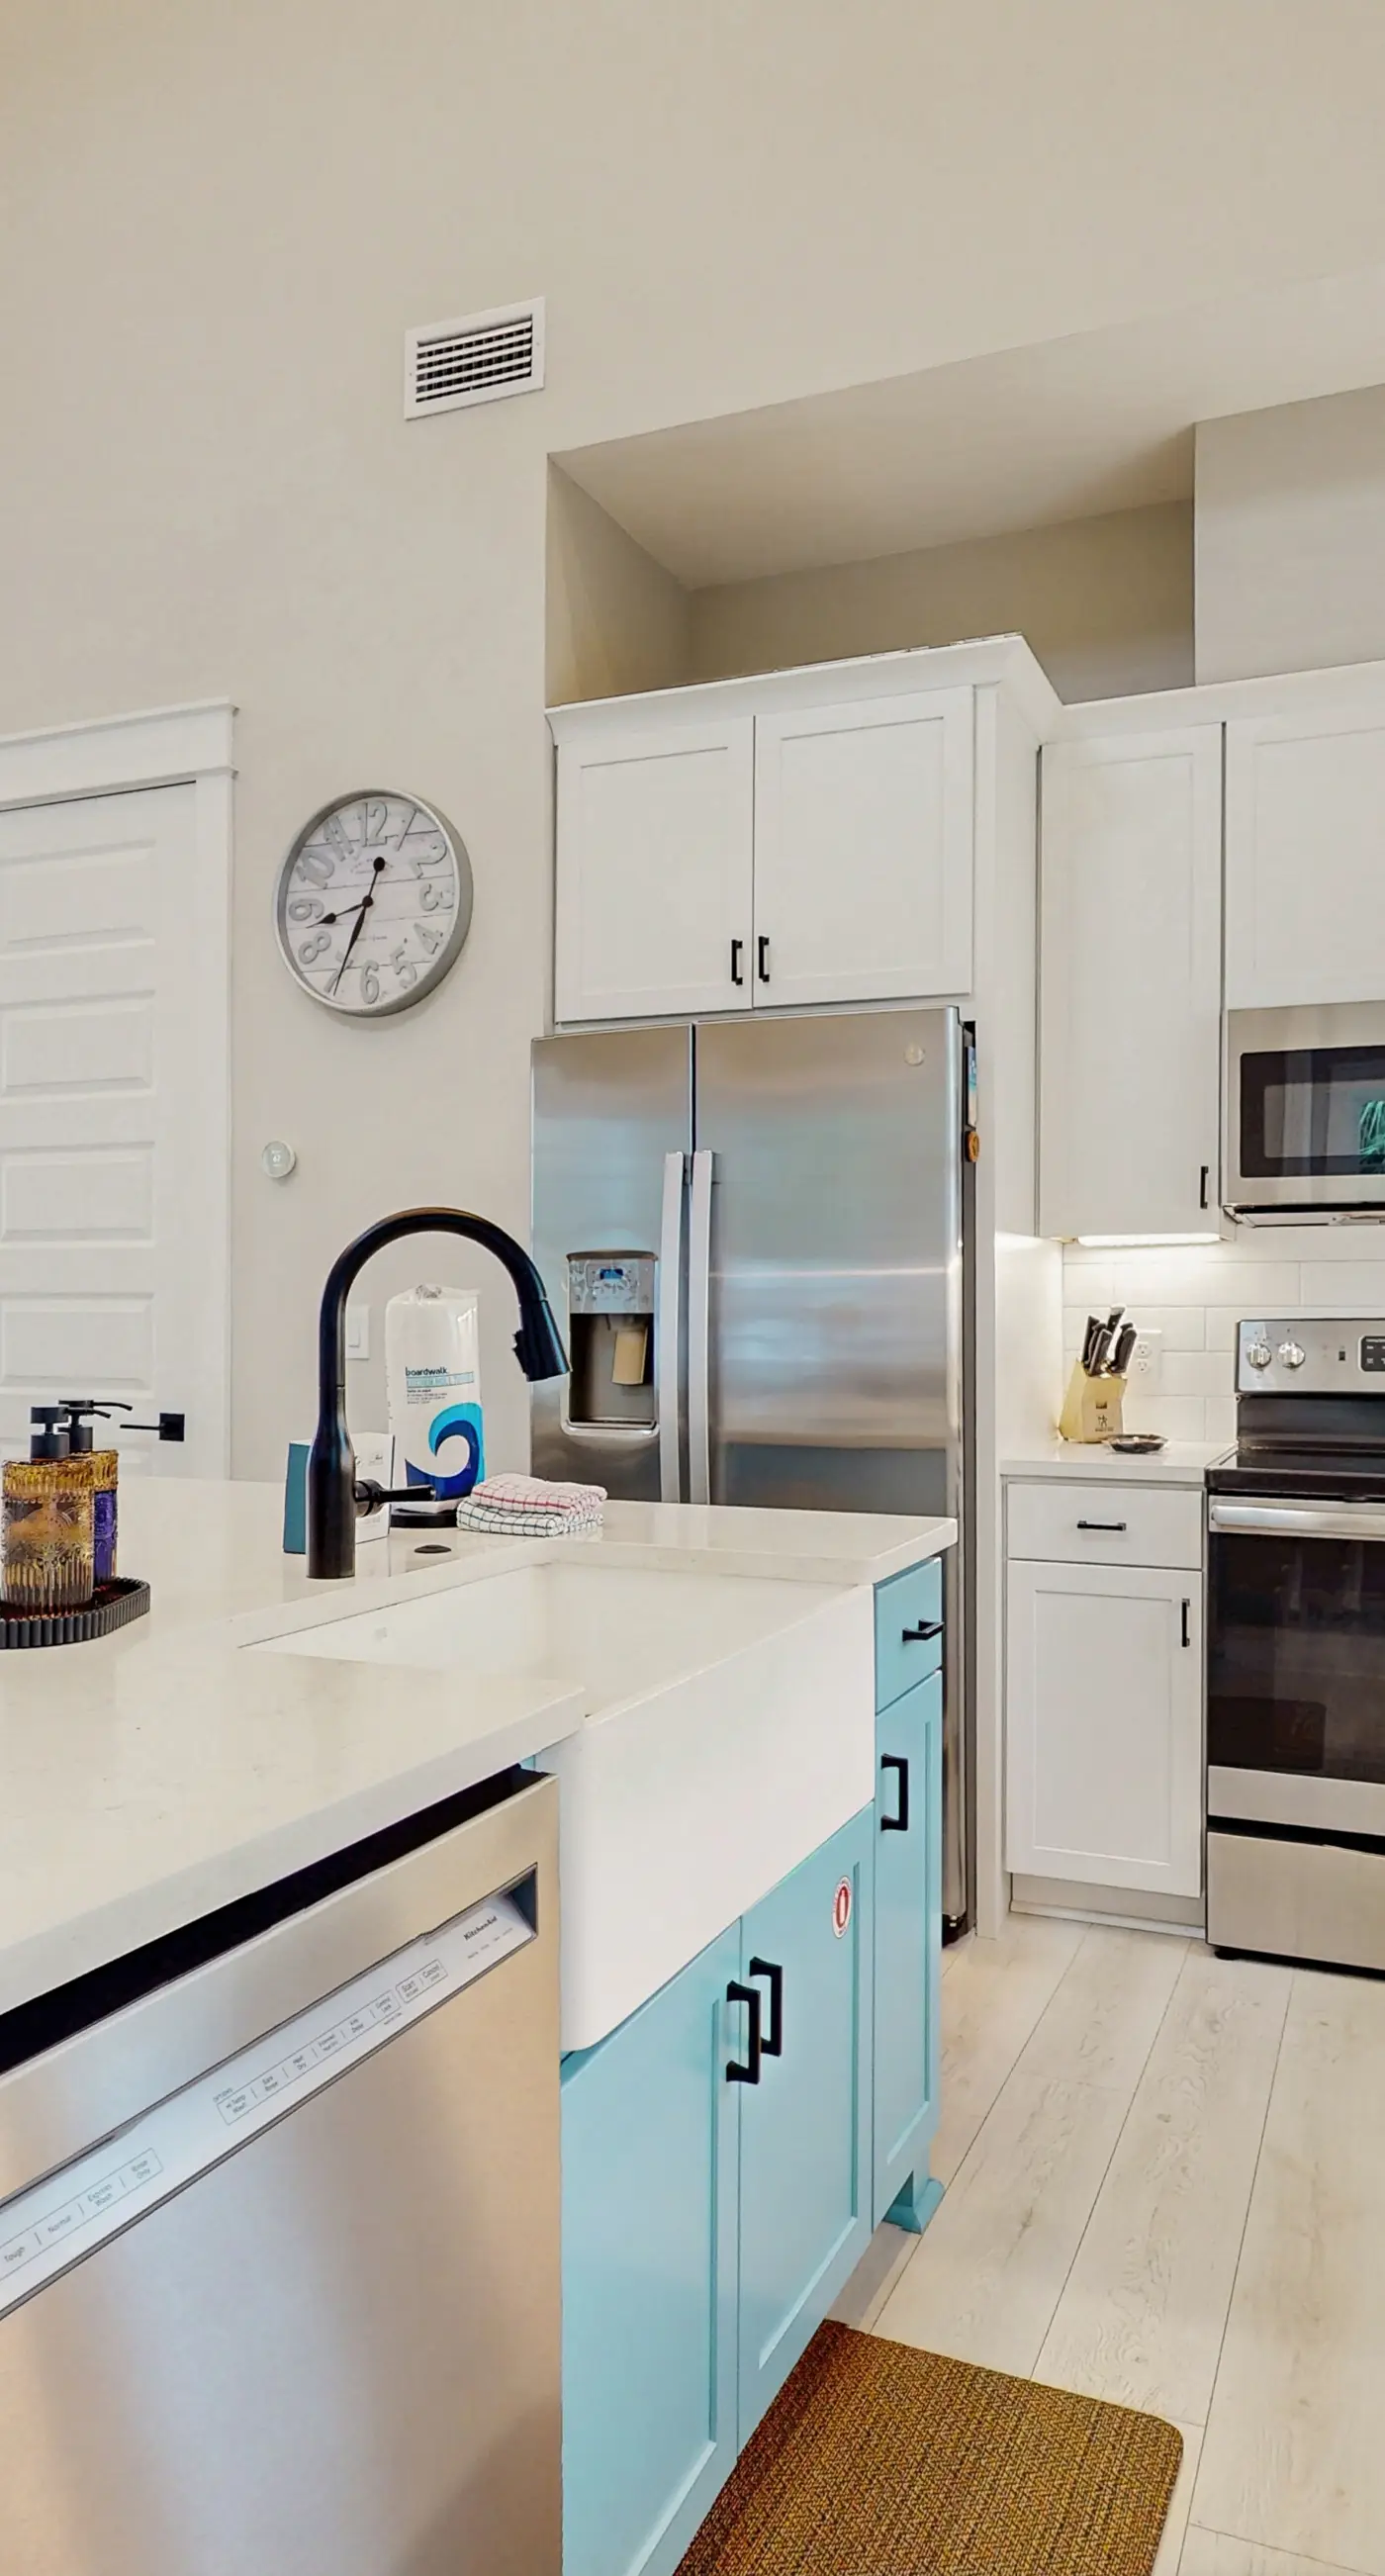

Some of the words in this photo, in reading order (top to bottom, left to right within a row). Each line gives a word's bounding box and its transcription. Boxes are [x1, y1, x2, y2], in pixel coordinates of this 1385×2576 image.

[323, 815, 354, 863] 11
[357, 801, 388, 847] 12
[297, 849, 335, 889] 10
[409, 840, 447, 879] 2
[289, 898, 324, 921] 9
[419, 883, 454, 912] 3
[298, 931, 331, 965] 8
[414, 923, 443, 956] 4
[323, 950, 353, 993] 7
[360, 960, 380, 1004] 6
[390, 938, 417, 989] 5
[405, 1366, 448, 1376] boardwalk
[463, 1915, 498, 1941] KitchenAid
